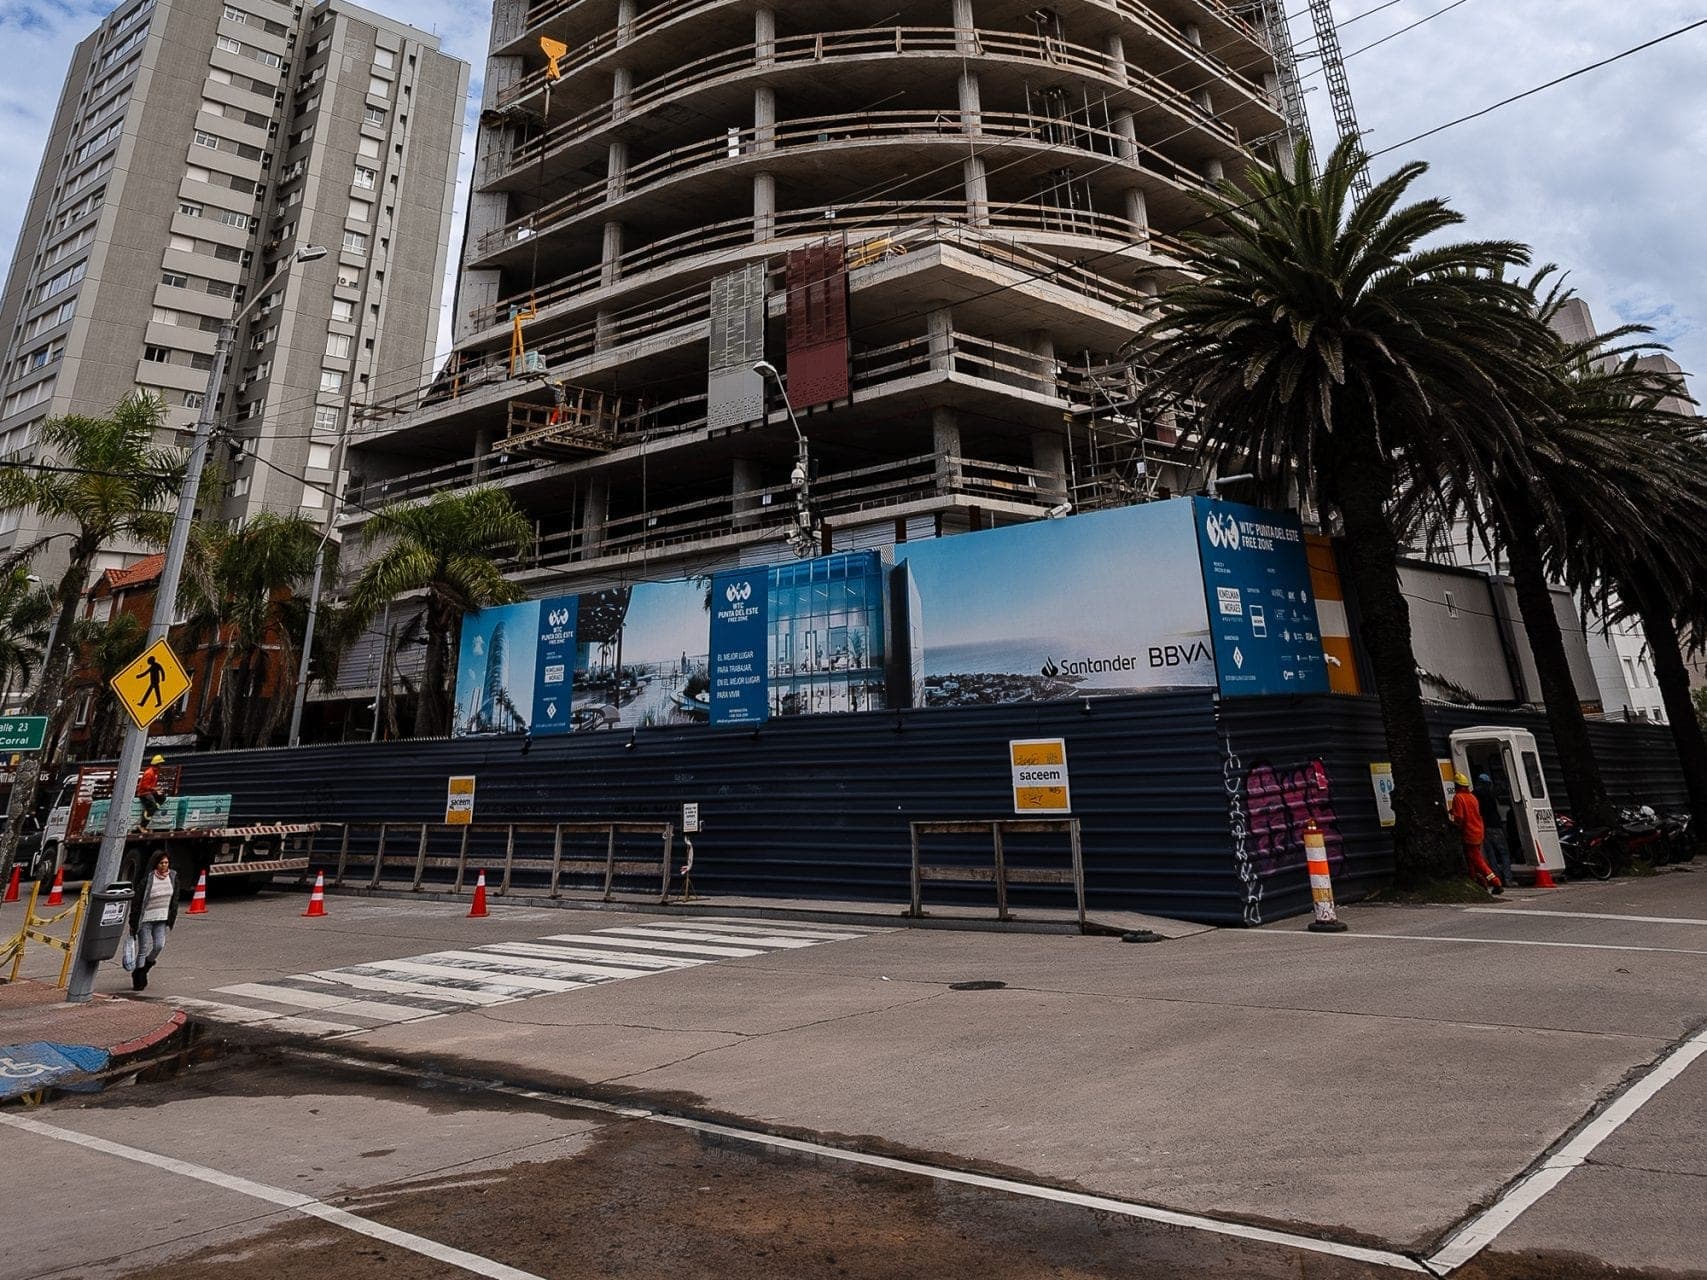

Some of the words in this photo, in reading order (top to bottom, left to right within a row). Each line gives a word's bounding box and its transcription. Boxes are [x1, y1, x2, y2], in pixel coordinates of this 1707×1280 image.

[1255, 523, 1275, 538] PUNTA
[1275, 526, 1286, 540] DEL
[1286, 529, 1299, 542] ESTE
[1242, 535, 1257, 550] FREE
[1258, 538, 1274, 551] ZONE
[718, 610, 734, 619] PUNTA
[735, 609, 745, 617] DEL
[746, 607, 759, 615] ESTE
[717, 653, 723, 662] EL
[723, 652, 738, 660] MEJOR
[738, 650, 754, 659] LUGAR
[1061, 655, 1137, 676] Santander
[1148, 641, 1212, 668] BBVA
[717, 665, 729, 674] PARA
[729, 663, 752, 673] TRABAJAR
[729, 676, 745, 685] MEJOR
[745, 675, 760, 684] LUGAR
[17, 723, 29, 732] 23
[0, 737, 29, 745] Corral
[1019, 770, 1061, 781] saceem
